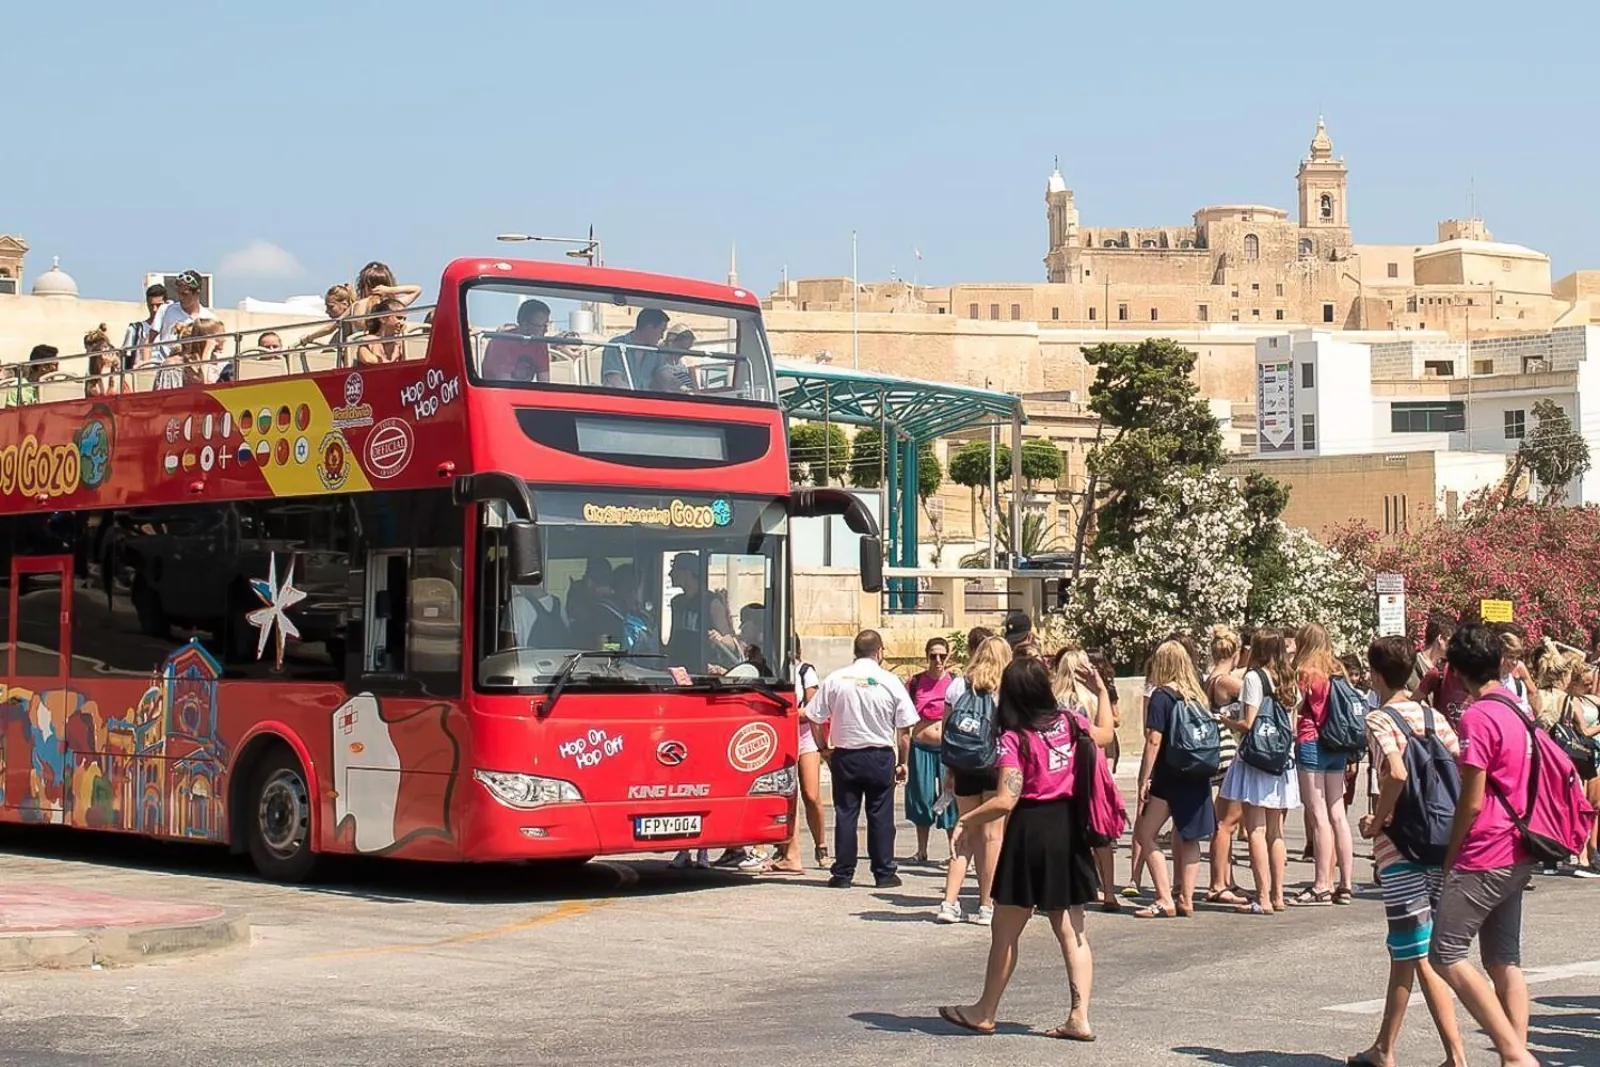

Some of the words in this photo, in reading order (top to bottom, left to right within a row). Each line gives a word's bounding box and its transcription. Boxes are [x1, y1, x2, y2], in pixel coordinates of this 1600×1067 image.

[401, 381, 424, 406] Hop
[427, 368, 444, 389] On
[414, 395, 439, 420] Hop
[441, 376, 459, 403] Off
[559, 738, 587, 758] Hop
[588, 729, 607, 746] On
[576, 749, 602, 769] Hop
[604, 735, 624, 756] Off
[628, 785, 667, 799] KING
[667, 784, 711, 798] LONG
